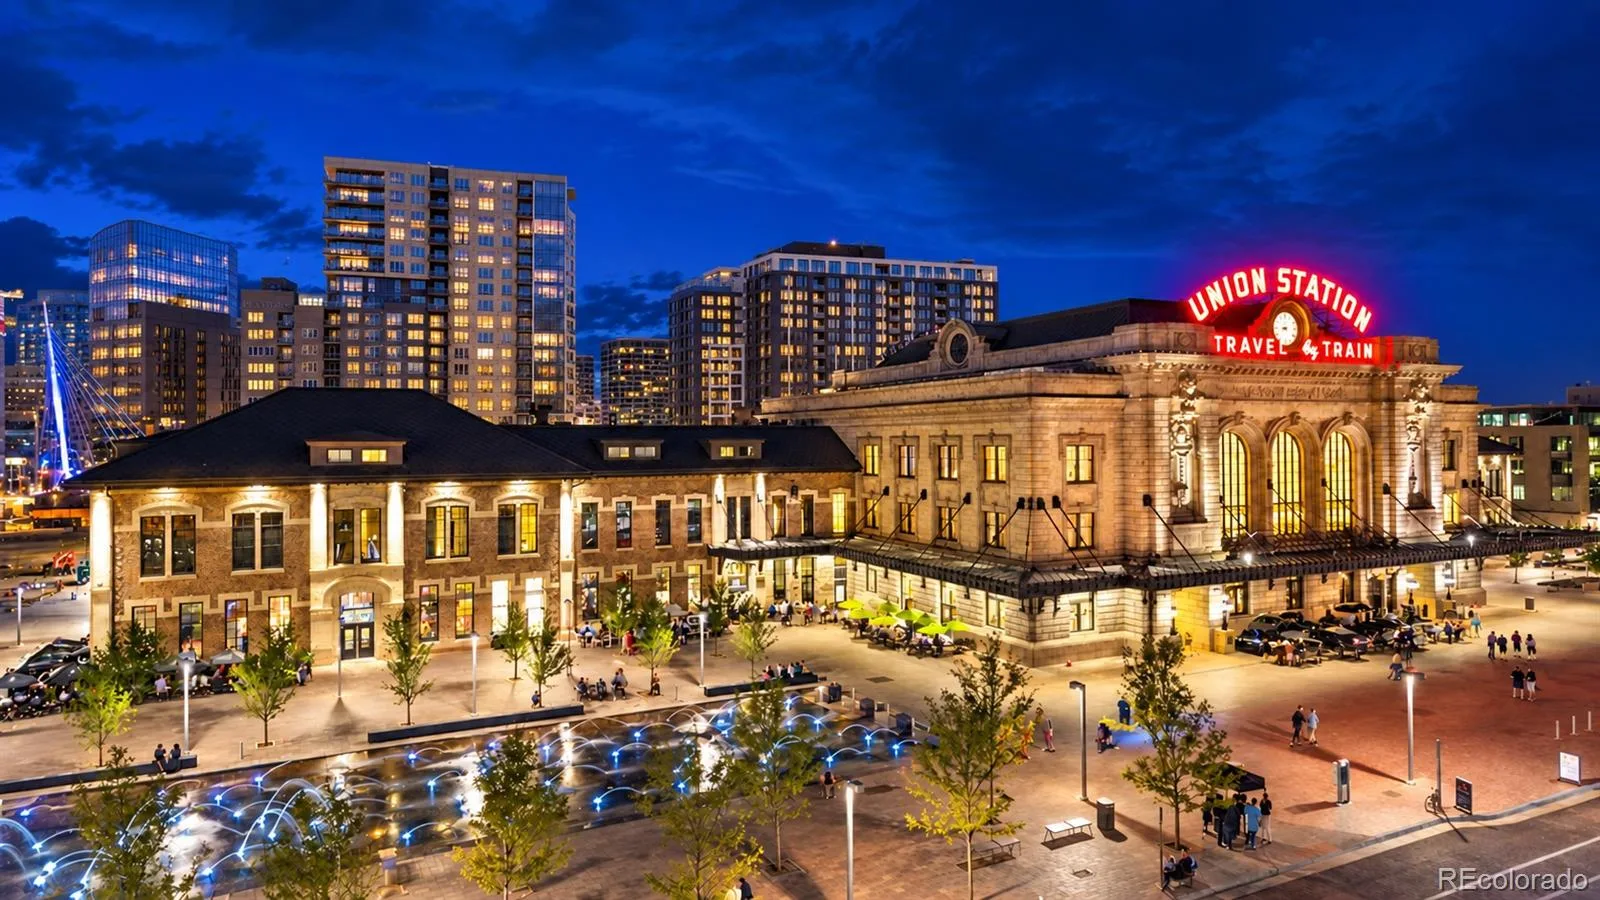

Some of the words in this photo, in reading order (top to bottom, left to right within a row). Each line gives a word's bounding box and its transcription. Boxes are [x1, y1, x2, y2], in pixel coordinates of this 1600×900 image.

[1188, 267, 1267, 322] UNION
[1277, 267, 1373, 333] STATION
[1214, 335, 1288, 355] TRAVEL
[1301, 339, 1320, 360] by
[1322, 341, 1373, 359] TRAIN
